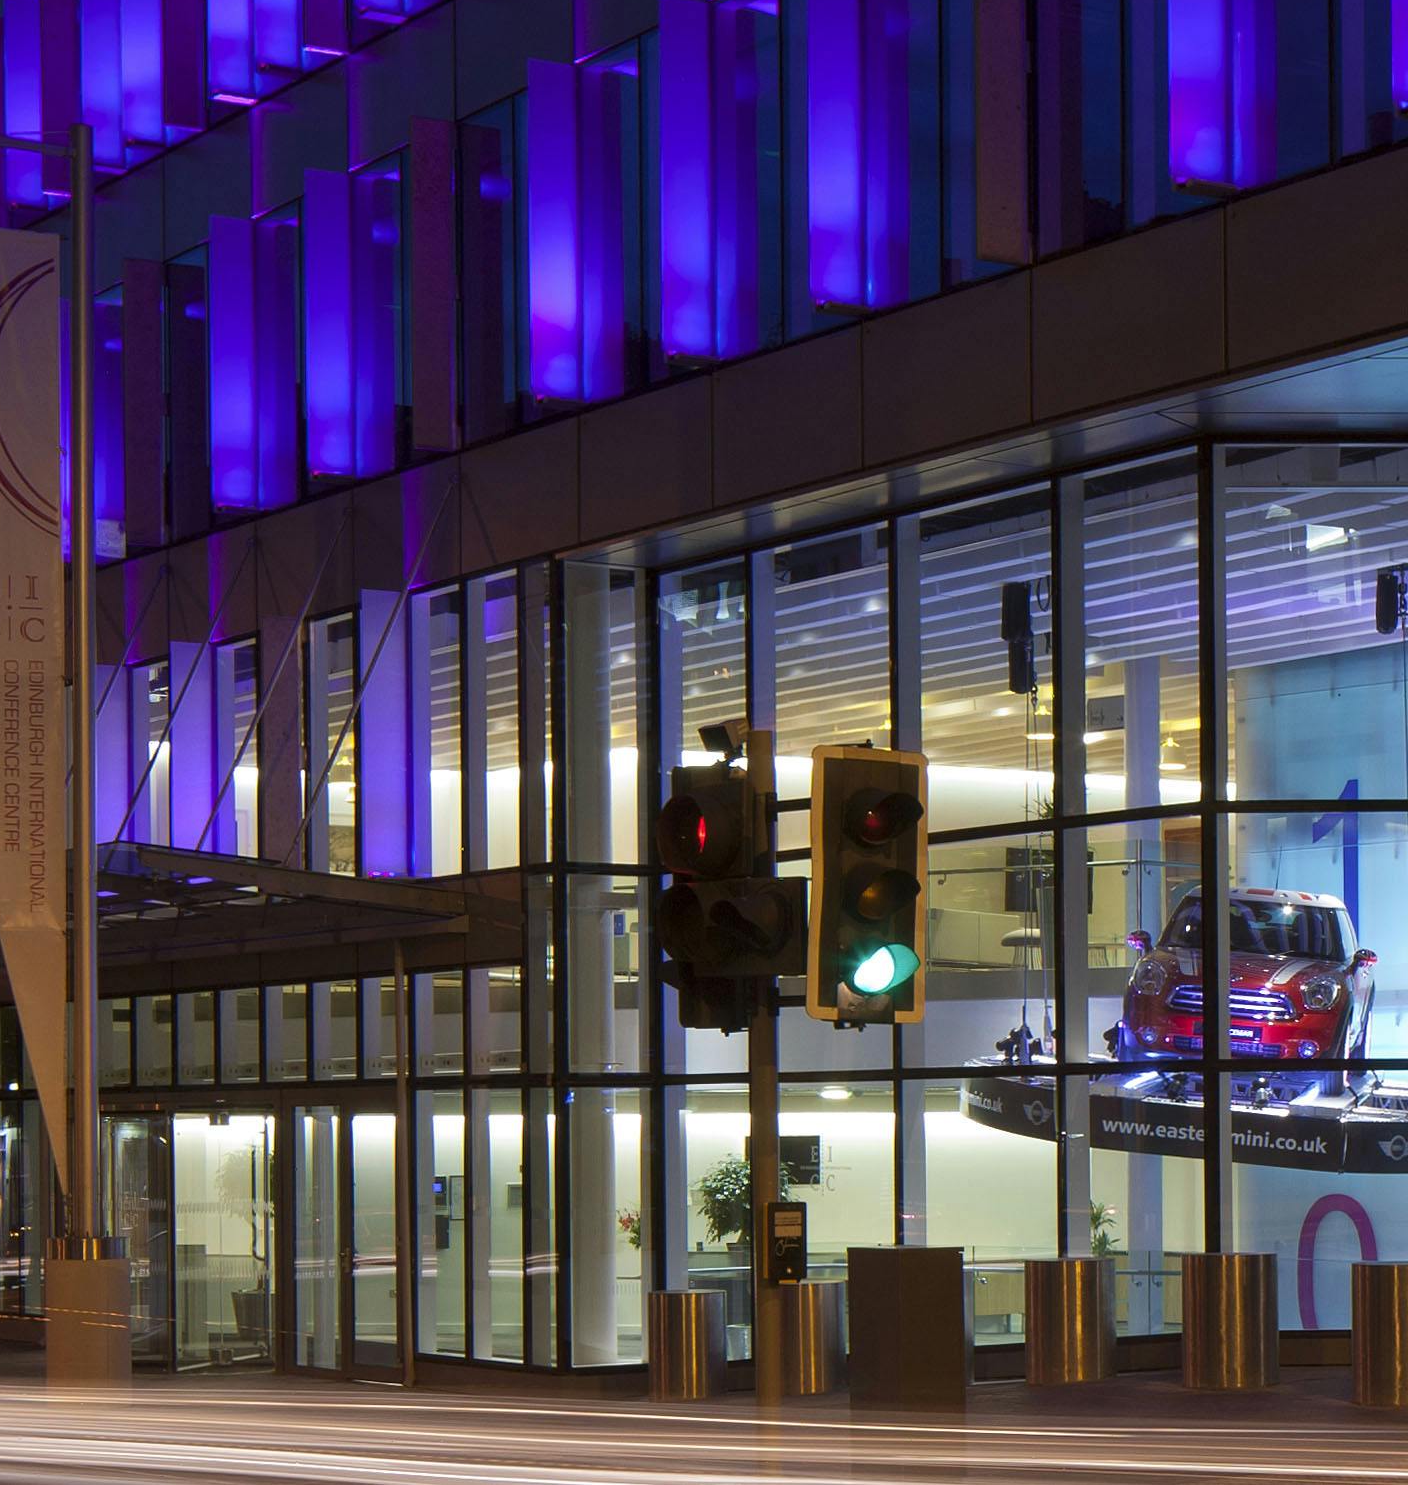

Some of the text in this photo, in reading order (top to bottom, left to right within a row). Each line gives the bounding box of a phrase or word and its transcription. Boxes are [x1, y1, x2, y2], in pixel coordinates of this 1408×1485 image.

[3, 659, 20, 852] CONFERENCE CENTRE
[28, 660, 46, 913] EDINBURGH INTERNATIONAL
